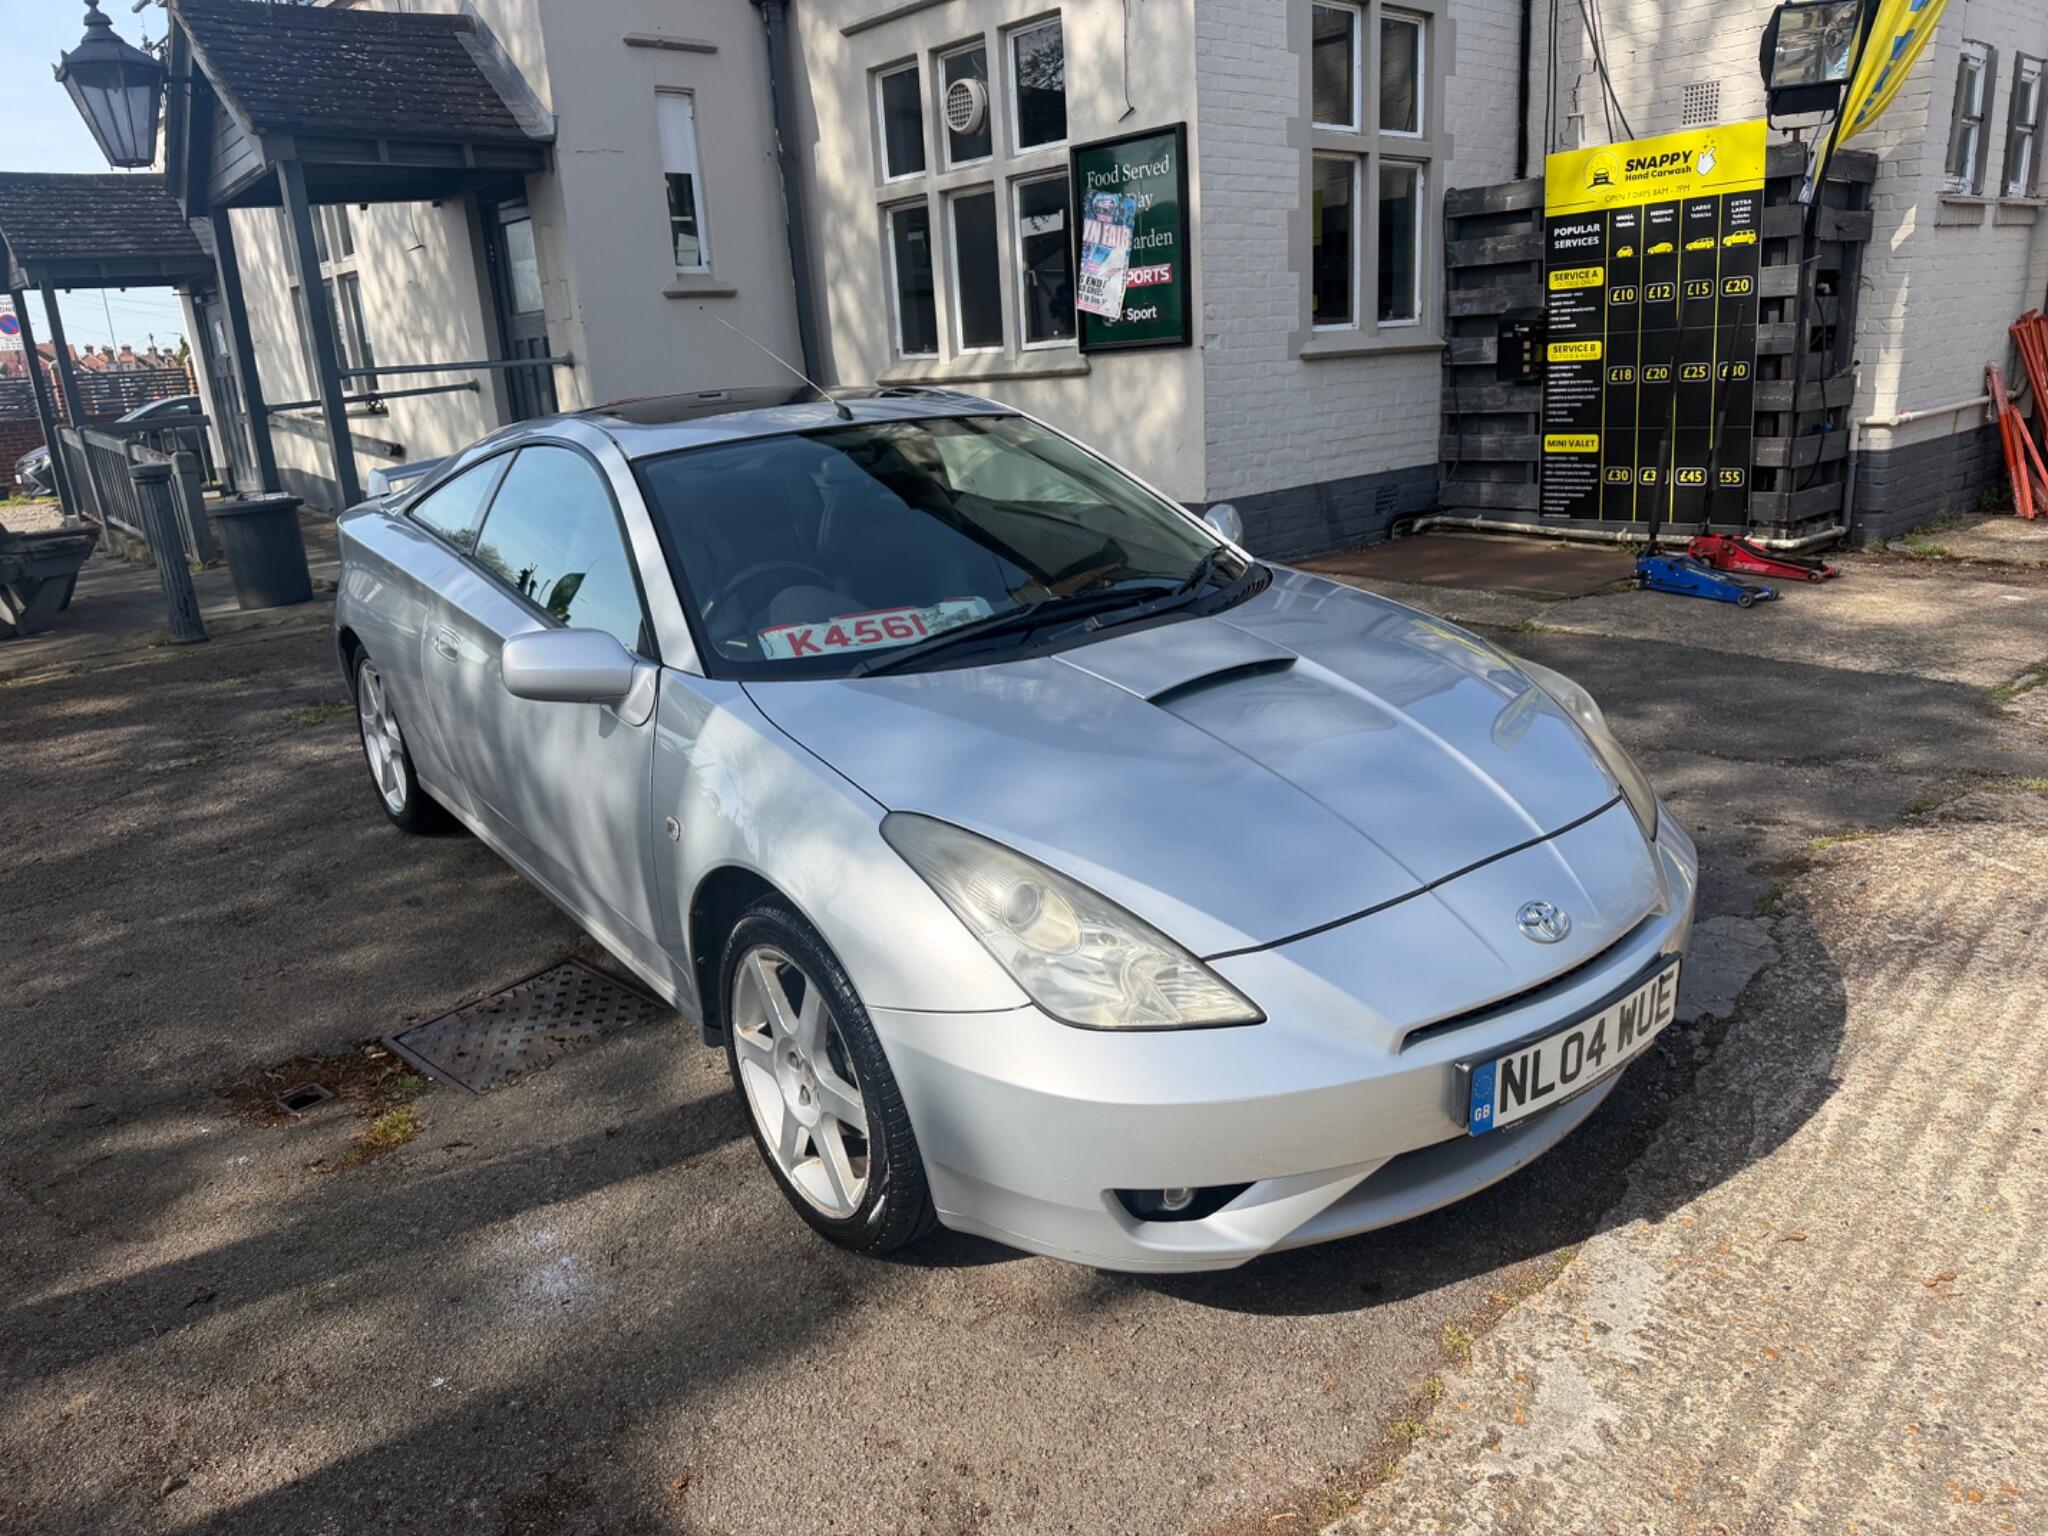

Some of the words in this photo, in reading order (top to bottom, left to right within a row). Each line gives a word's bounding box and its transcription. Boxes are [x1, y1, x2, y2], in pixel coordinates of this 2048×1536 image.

[1625, 150, 1693, 173] SNAPPY
[1087, 164, 1119, 189] Food
[1122, 153, 1170, 183] Served
[1625, 172, 1649, 182] Hand
[1651, 165, 1692, 178] Carwash
[1604, 194, 1625, 203] OPEN
[1554, 223, 1600, 238] POPULAR
[1133, 229, 1173, 250] arden
[1554, 236, 1600, 249] SERVICES
[1127, 266, 1170, 285] PORTS
[1554, 270, 1590, 281] SERVICE
[1592, 269, 1599, 278] A
[1648, 285, 1671, 299] £12
[1687, 282, 1710, 296] £15
[1725, 279, 1749, 293] £20
[1613, 288, 1635, 301] £10
[1127, 305, 1157, 322] Sport
[1553, 344, 1589, 353] SERVICE
[1611, 369, 1632, 381] £18
[1646, 367, 1667, 380] £20
[1683, 366, 1706, 378] £25
[1547, 440, 1566, 448] MINI
[1568, 439, 1595, 448] VALET
[1607, 470, 1628, 481] £30
[1680, 470, 1702, 482] £45
[1720, 471, 1740, 483] £55
[1500, 1017, 1607, 1114] NL04
[1617, 969, 1674, 1053] WUE
[1474, 1103, 1491, 1122] GB
